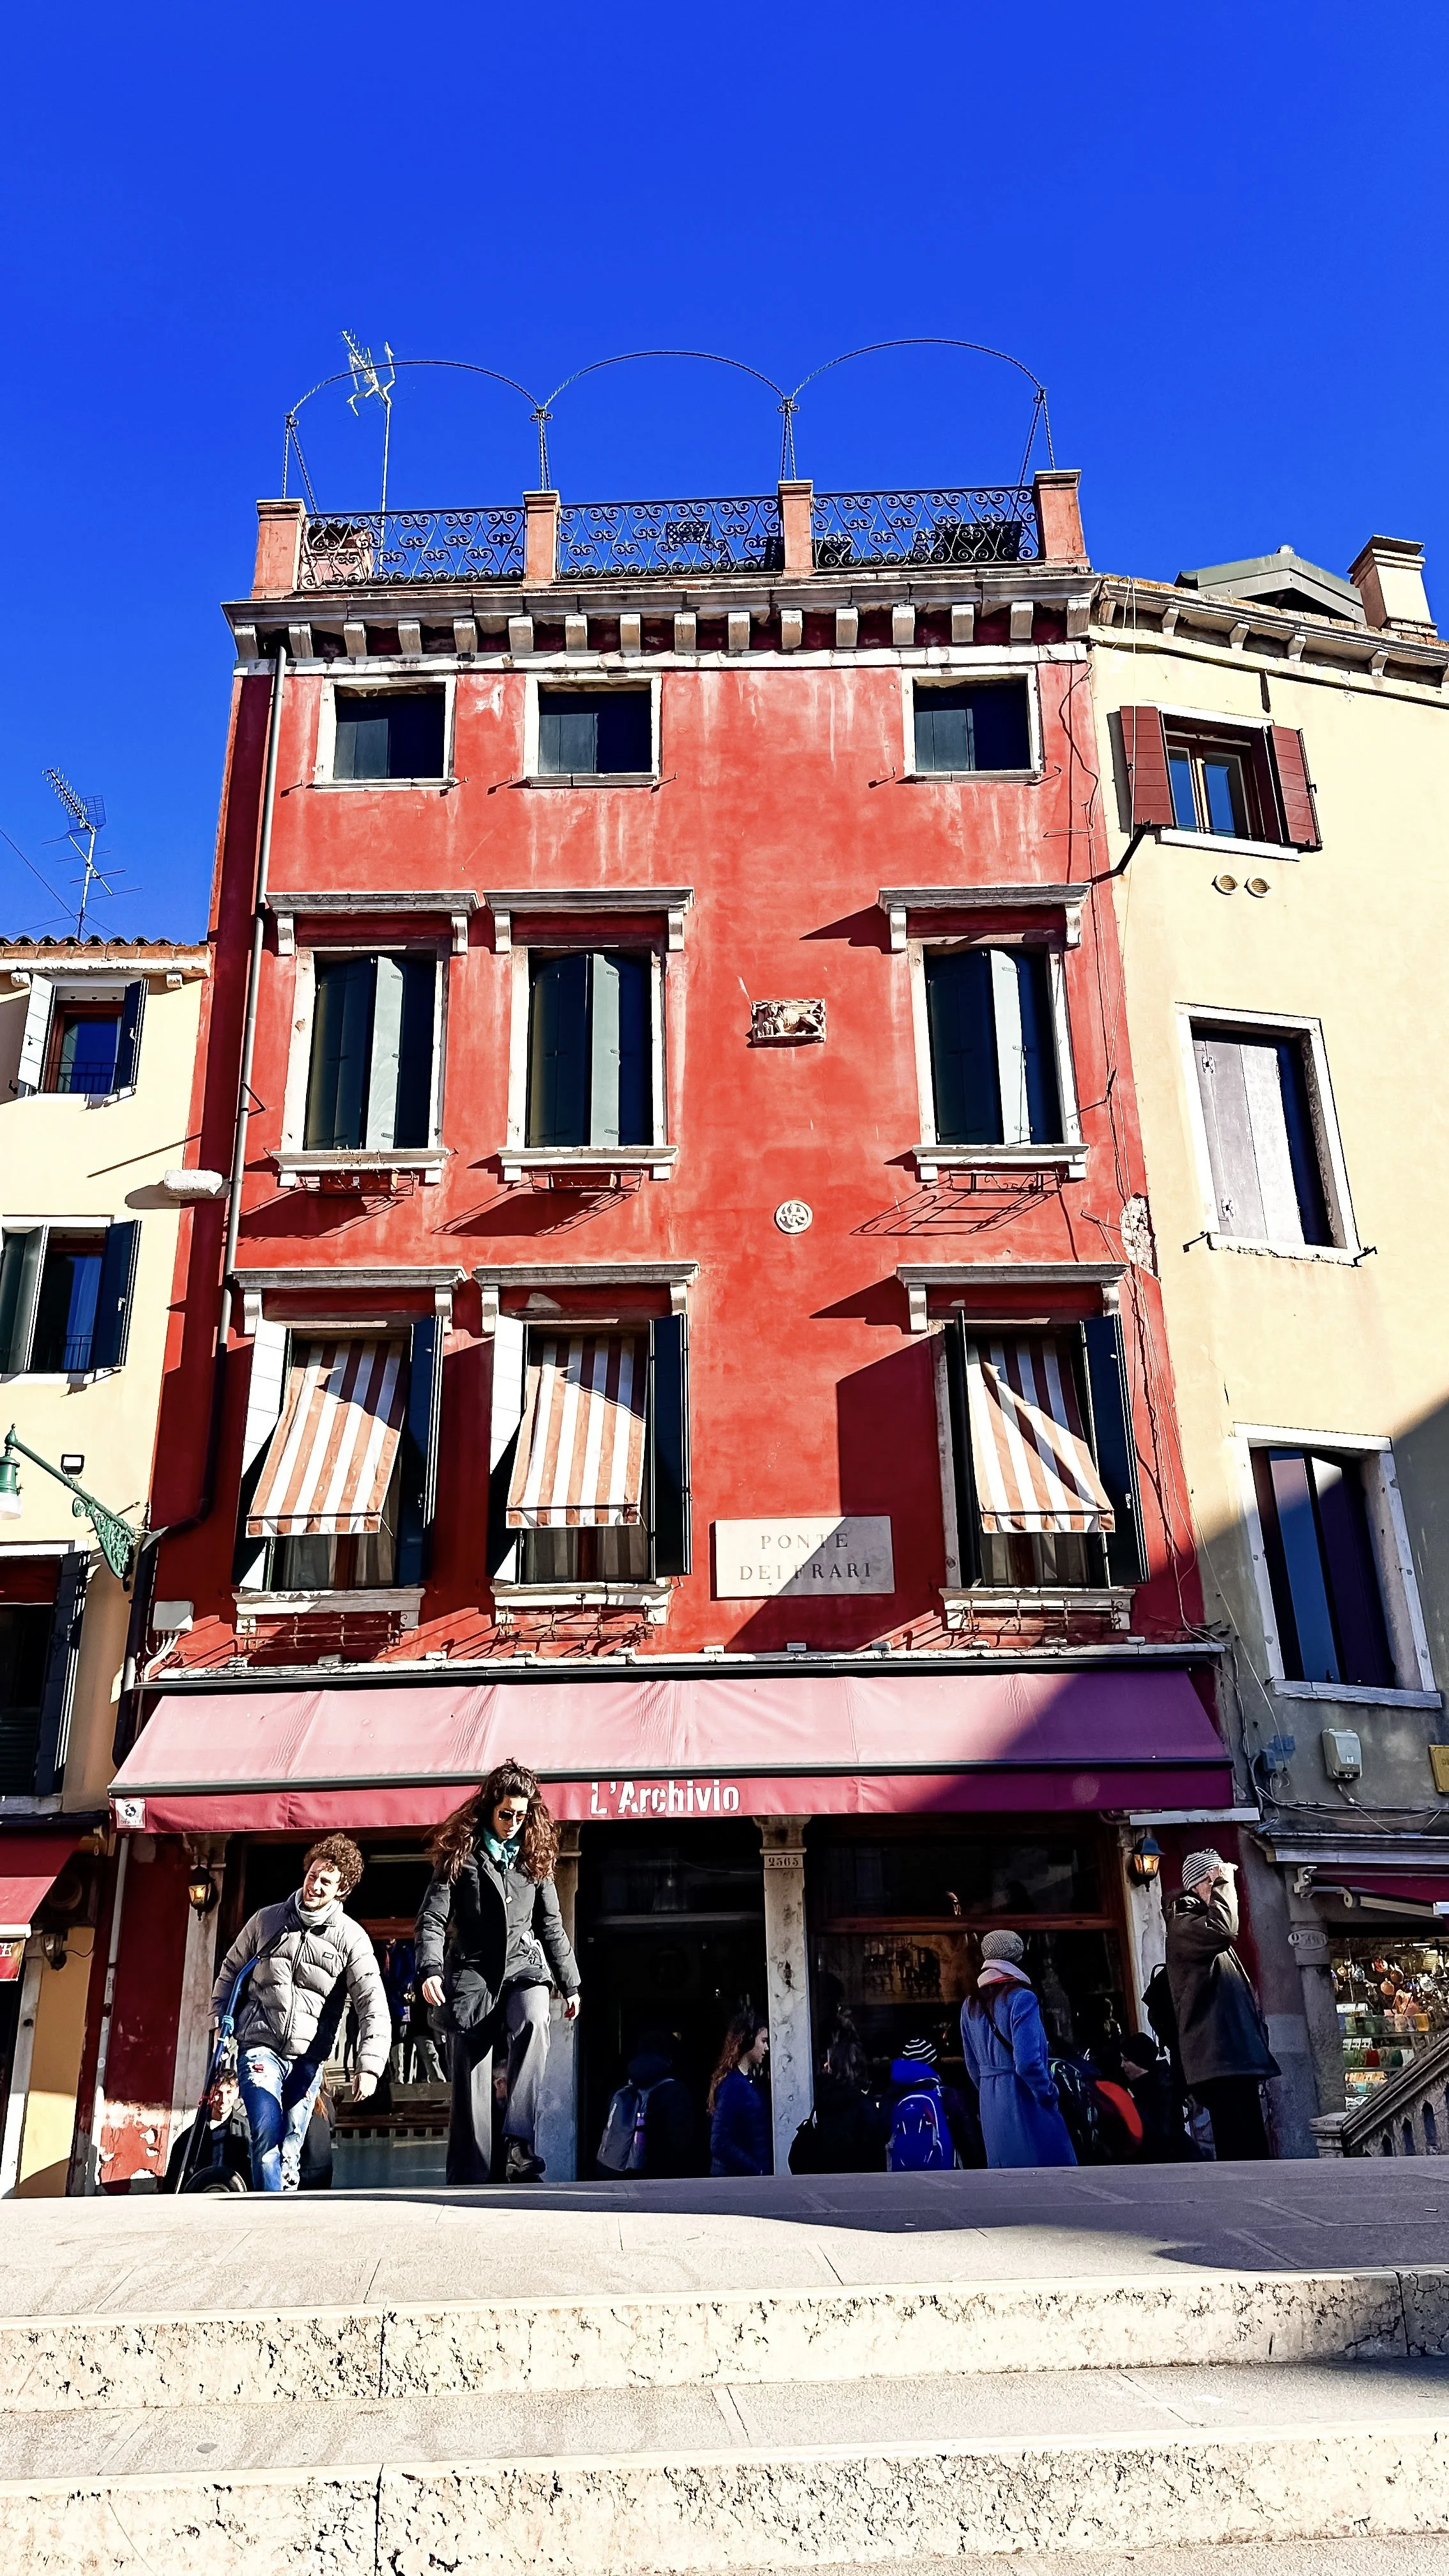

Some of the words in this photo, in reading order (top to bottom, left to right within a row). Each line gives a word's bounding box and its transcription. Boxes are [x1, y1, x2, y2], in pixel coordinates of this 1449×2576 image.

[761, 1533, 848, 1549] PONTE
[739, 1565, 782, 1580] DEI
[794, 1563, 871, 1580] FRARI
[590, 1780, 740, 1814] L'Archivio
[769, 1857, 799, 1867] 2565
